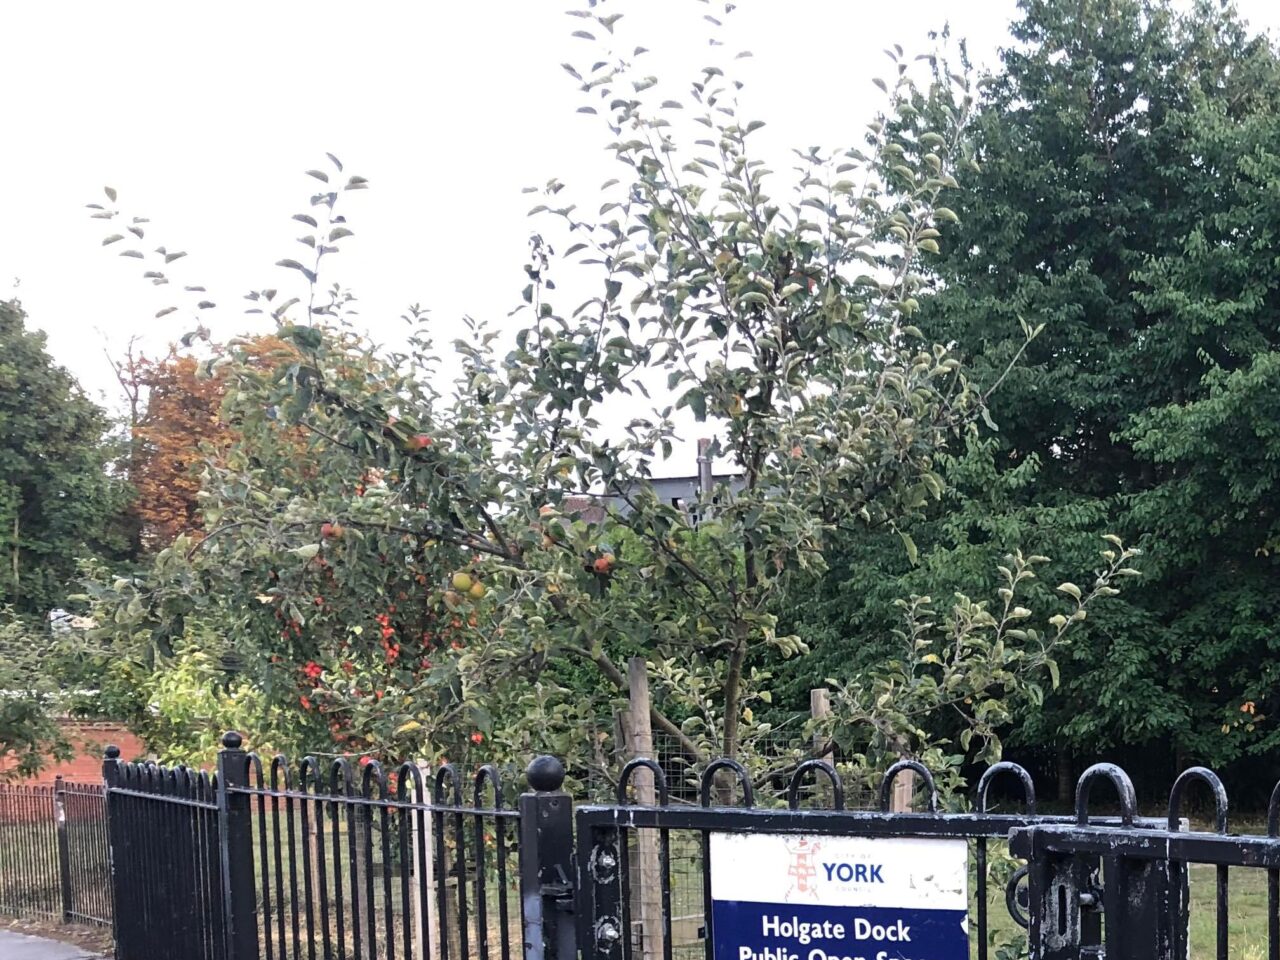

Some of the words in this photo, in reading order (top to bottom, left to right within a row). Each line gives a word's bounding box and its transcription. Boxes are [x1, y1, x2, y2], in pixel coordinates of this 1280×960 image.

[823, 863, 884, 883] YORK
[762, 914, 845, 945] Holgate
[854, 917, 912, 942] Dock
